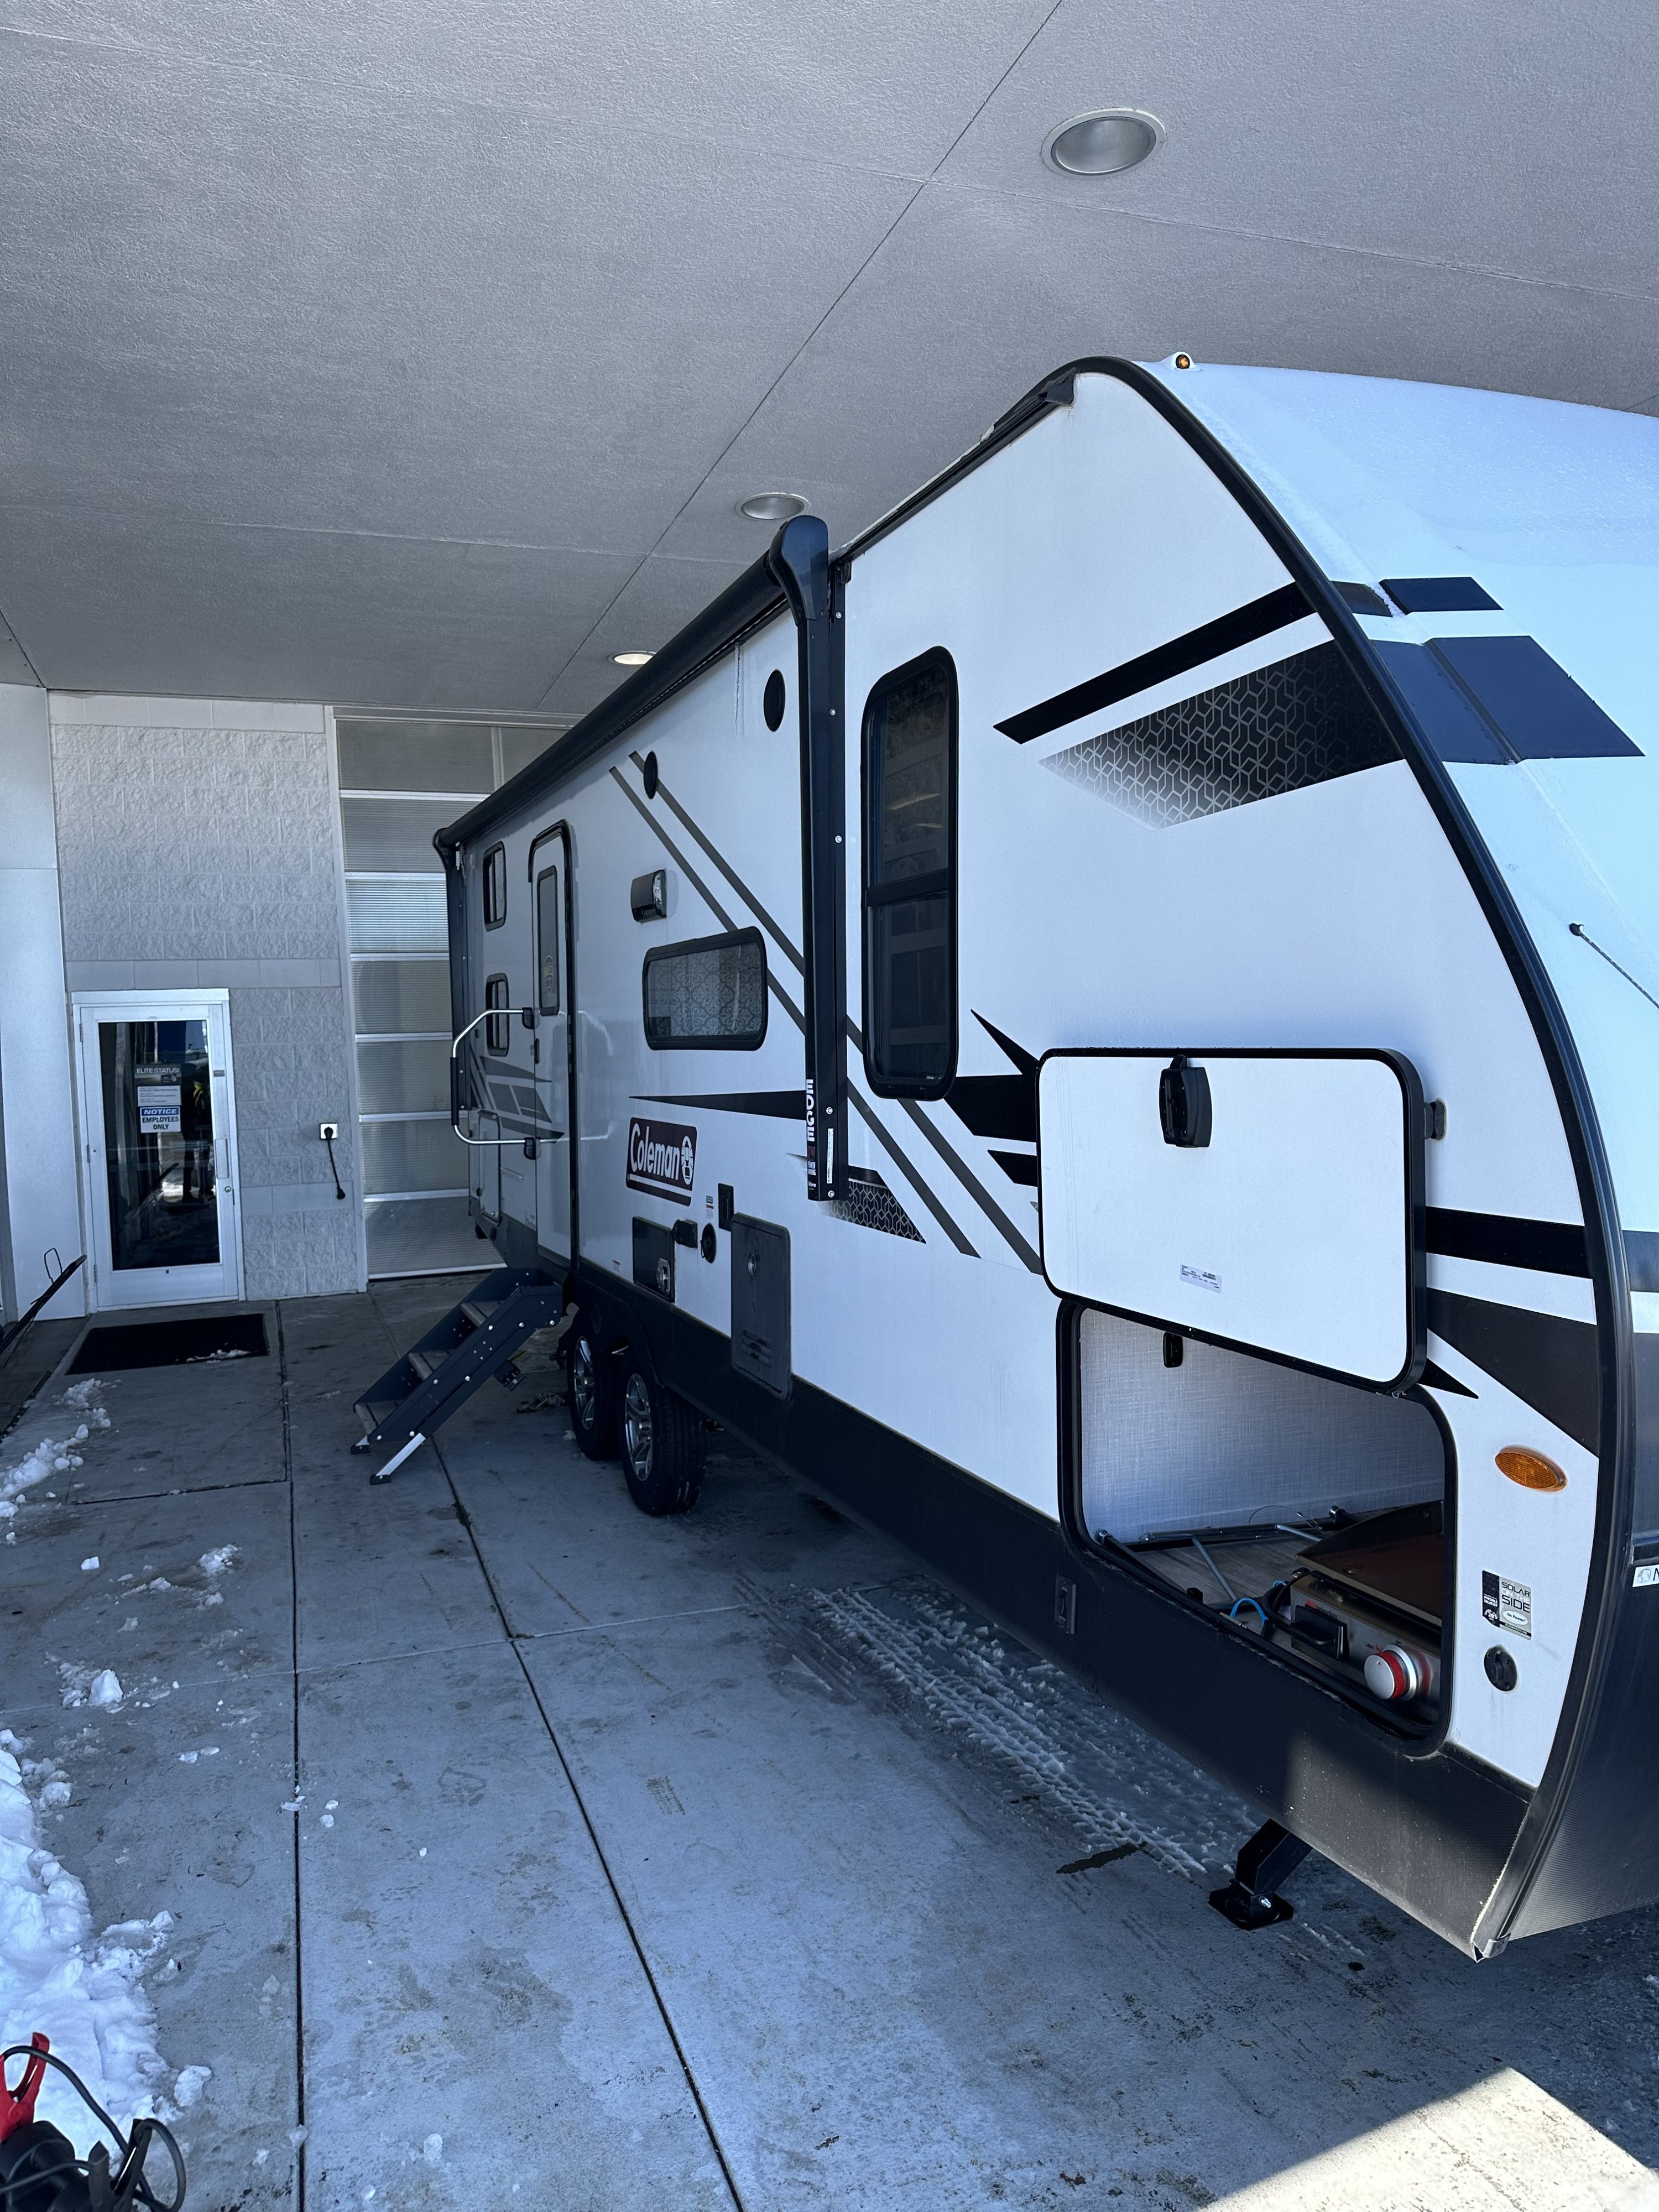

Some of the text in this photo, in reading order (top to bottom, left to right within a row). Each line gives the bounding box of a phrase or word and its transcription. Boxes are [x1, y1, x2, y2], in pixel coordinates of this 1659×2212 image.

[806, 1079, 815, 1142] EDGE
[630, 1123, 680, 1180] Coleman
[1501, 1582, 1530, 1598] SOLAR
[1501, 1588, 1514, 1598] ON
[1515, 1593, 1530, 1603] THE
[1501, 1594, 1530, 1613] SIDE
